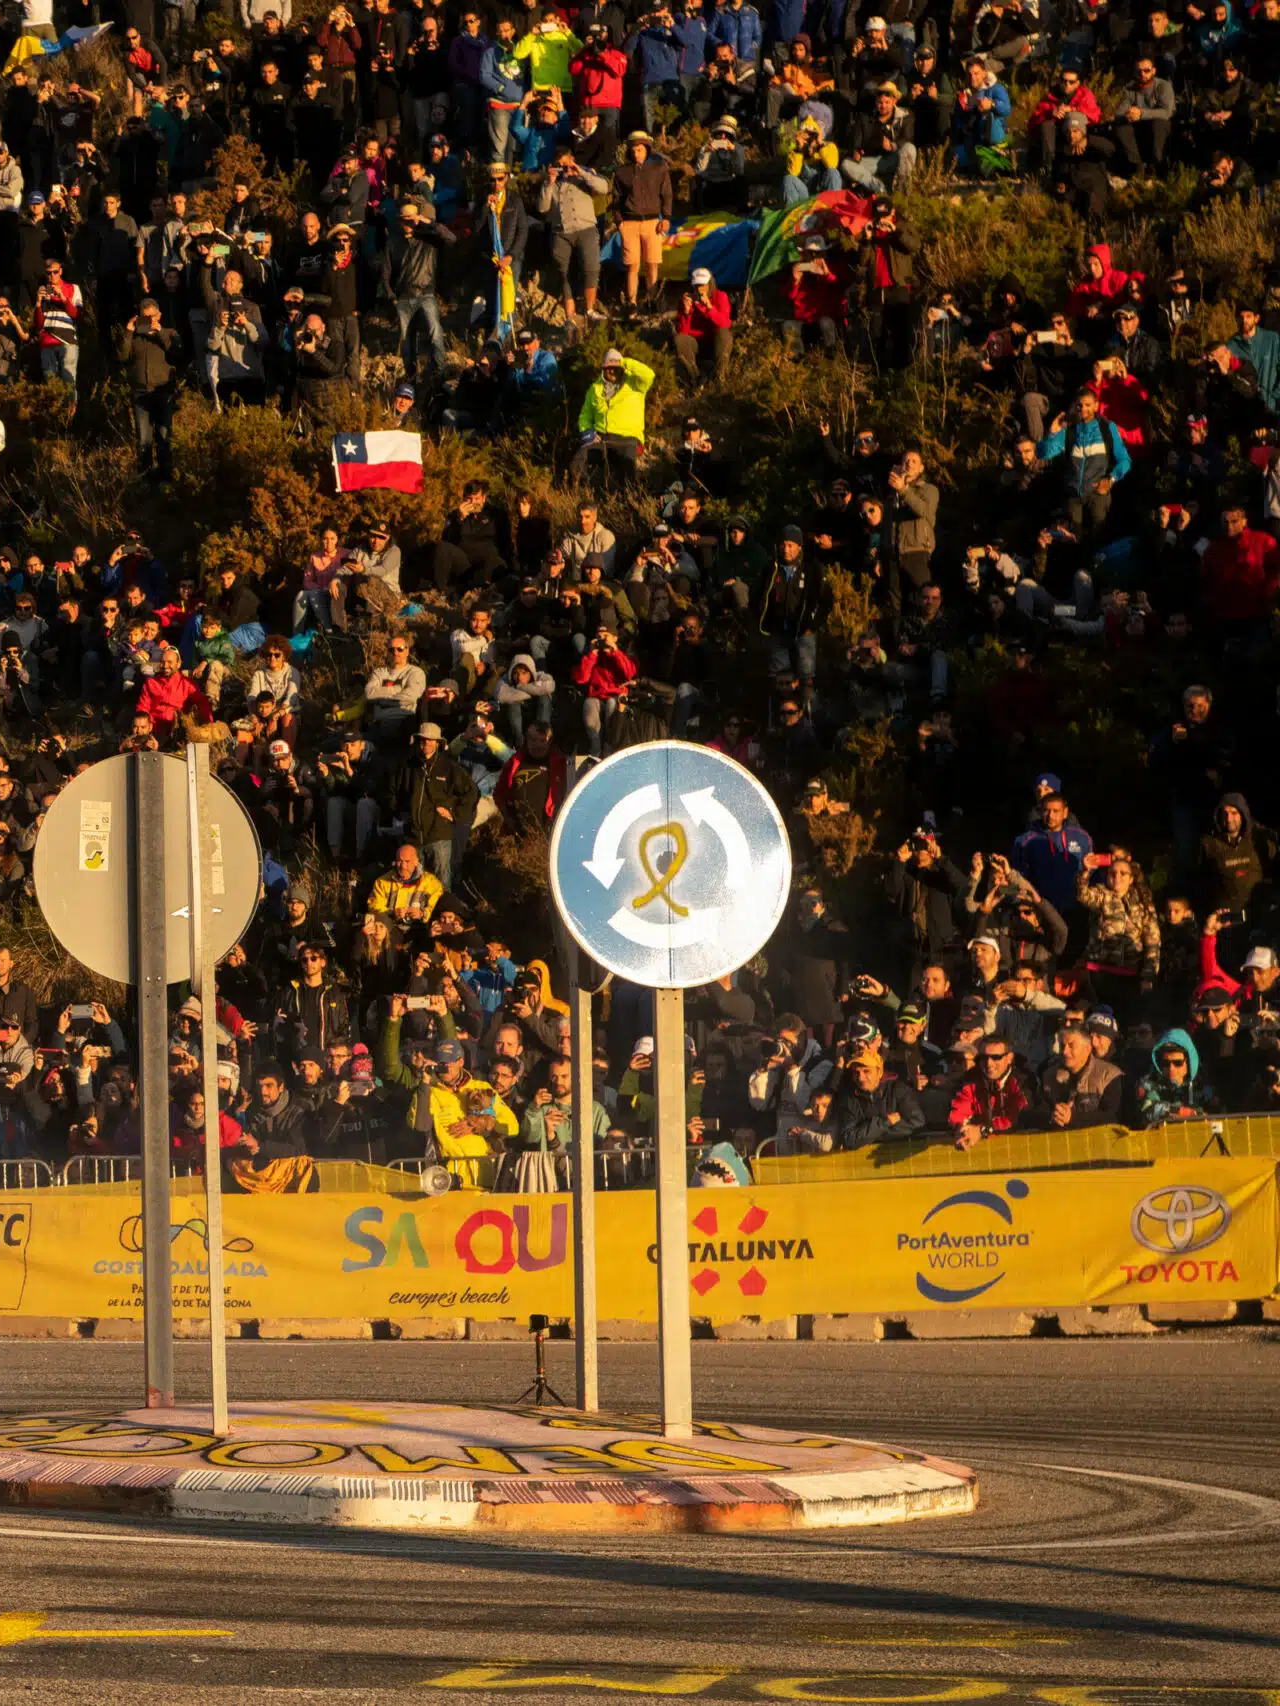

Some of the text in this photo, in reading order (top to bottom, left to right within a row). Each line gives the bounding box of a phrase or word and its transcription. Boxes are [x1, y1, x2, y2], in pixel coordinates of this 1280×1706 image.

[342, 1203, 568, 1274] SAOU
[897, 1231, 1029, 1250] PortAventura
[646, 1238, 815, 1265] CTALUNYA
[928, 1252, 999, 1268] WORLD
[93, 1260, 268, 1277] COST DAUADA
[1119, 1260, 1239, 1284] TOYOTA
[196, 1298, 252, 1308] TARGONA
[389, 1286, 510, 1308] europe's beach
